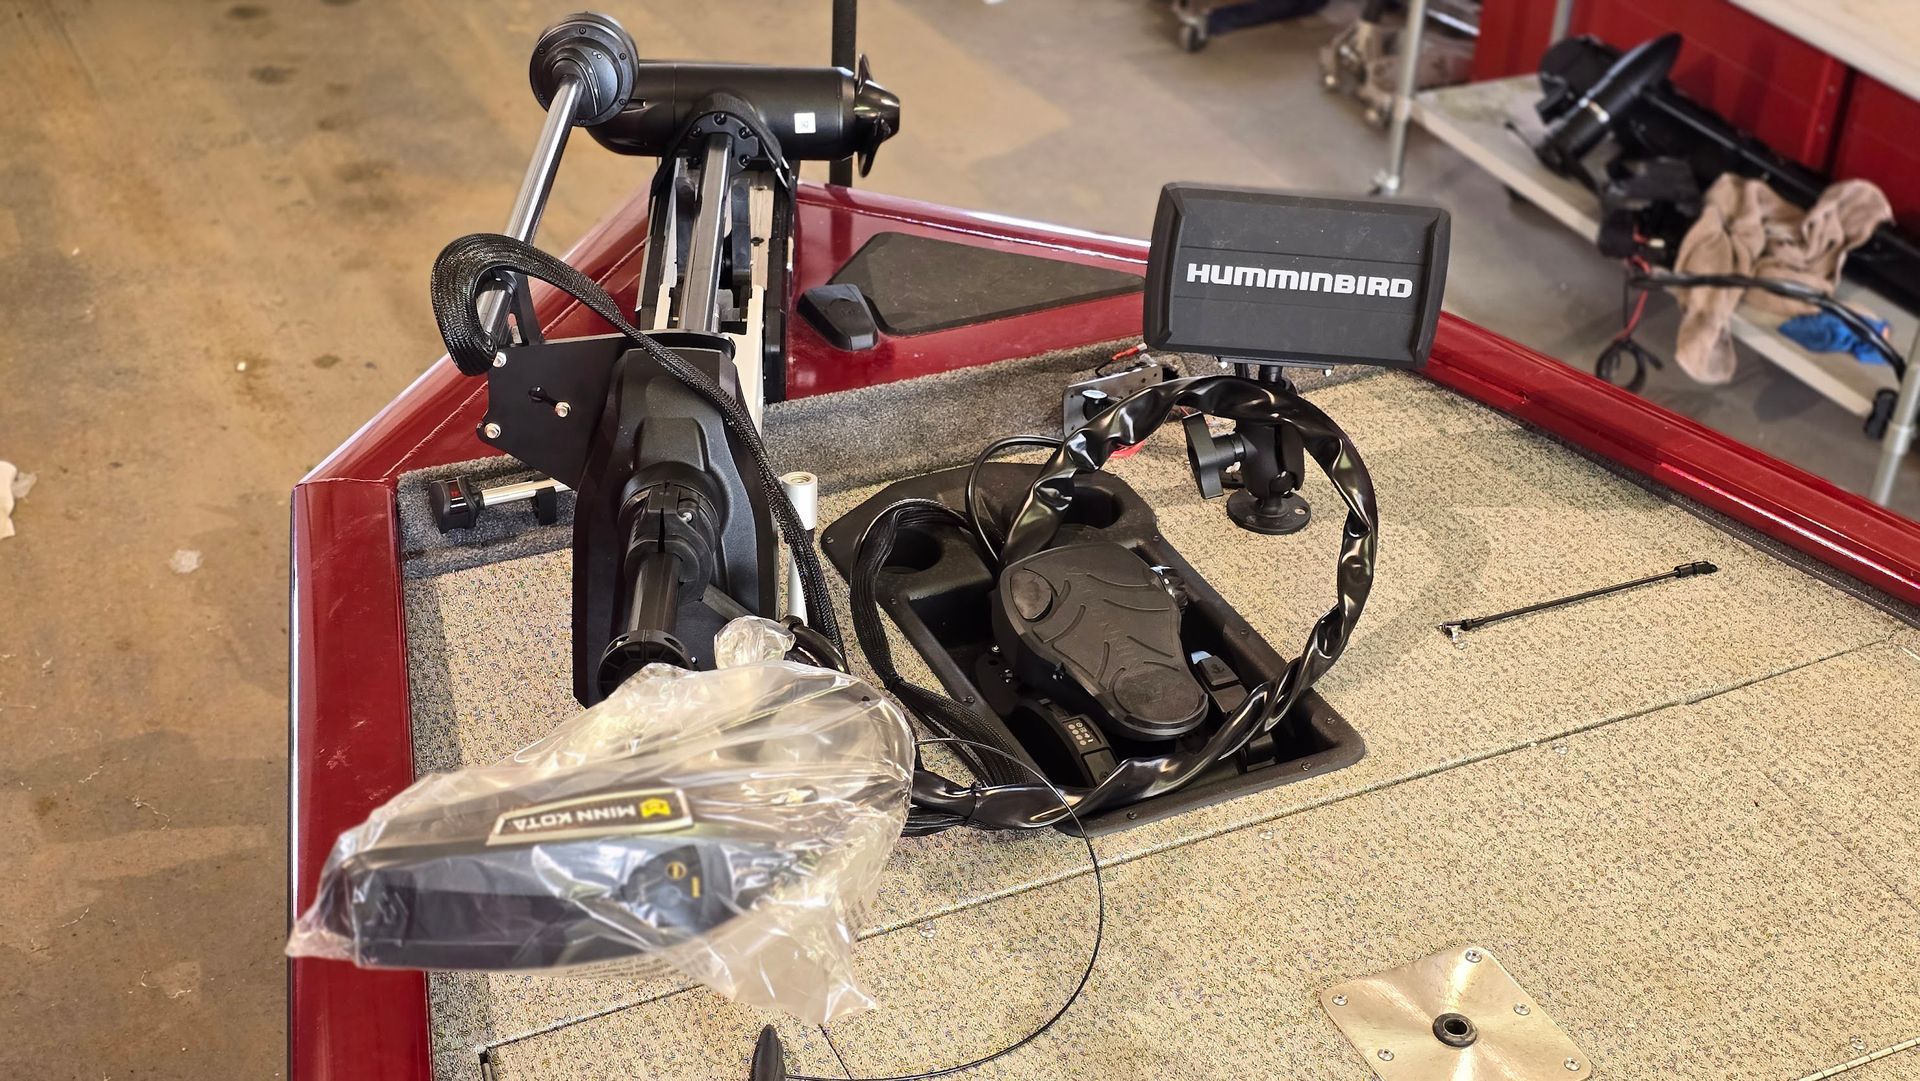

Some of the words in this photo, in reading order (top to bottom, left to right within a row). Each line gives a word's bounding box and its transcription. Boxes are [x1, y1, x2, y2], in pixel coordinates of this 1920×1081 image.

[1187, 263, 1413, 298] HUMMINBIRD
[514, 811, 572, 831] KOTA
[577, 805, 636, 822] MINN
